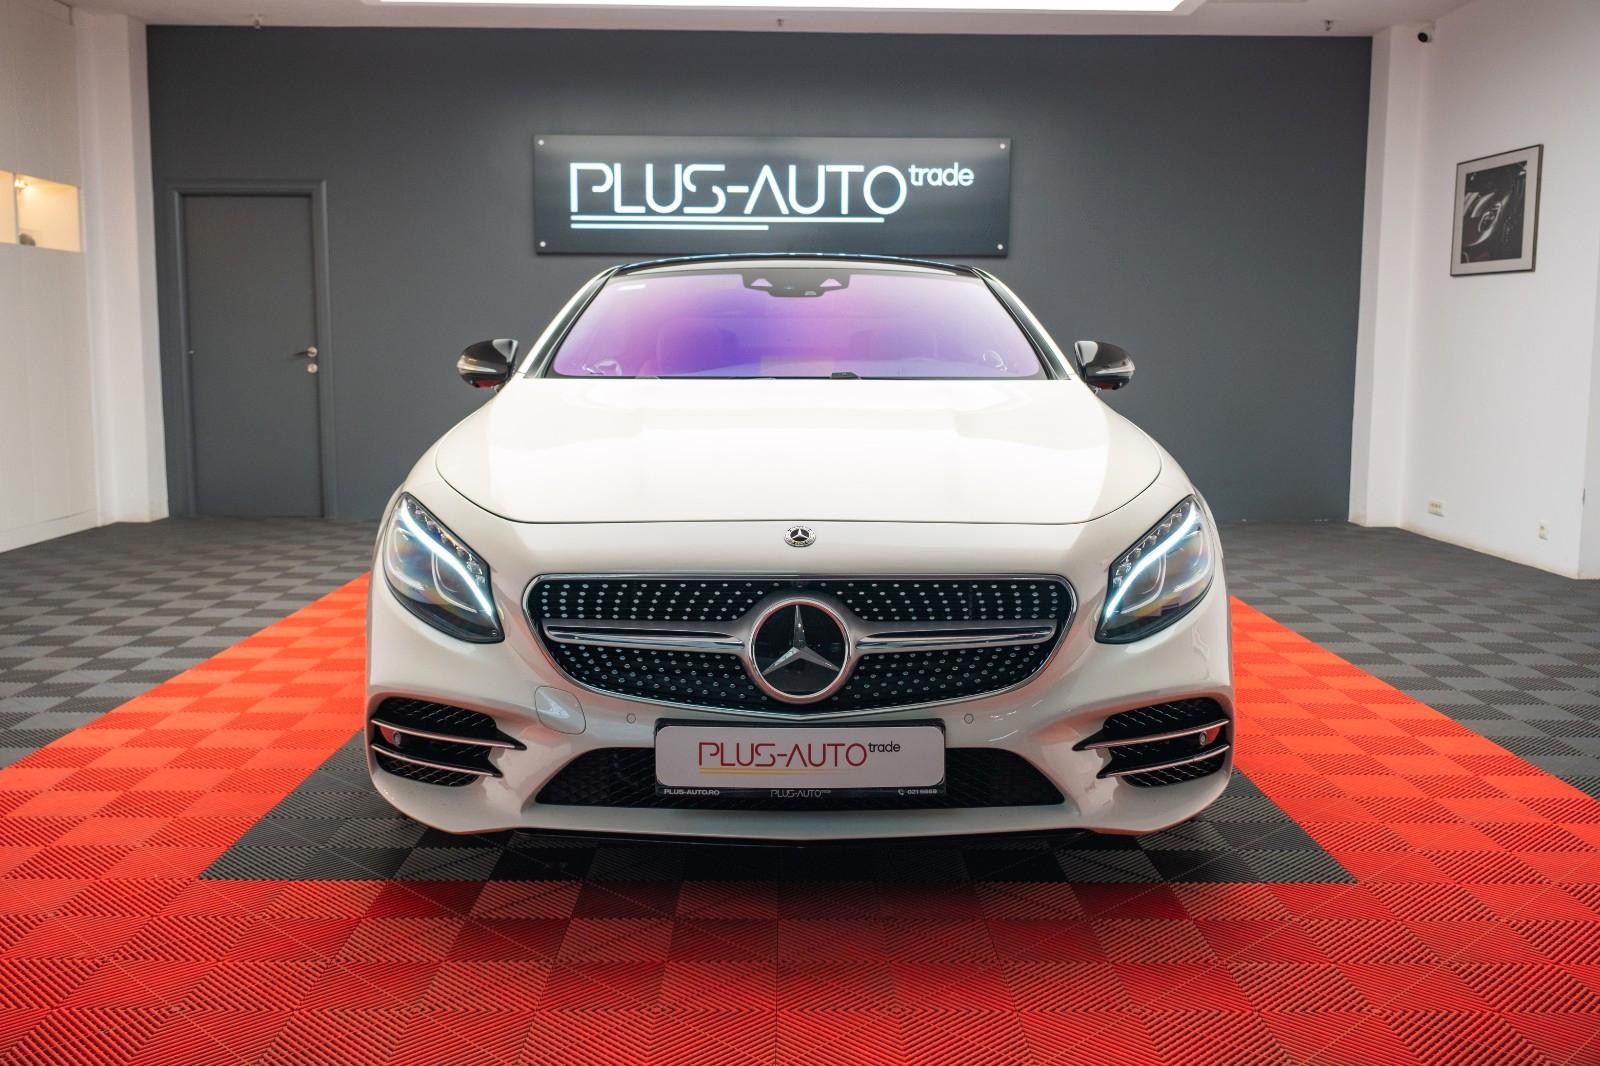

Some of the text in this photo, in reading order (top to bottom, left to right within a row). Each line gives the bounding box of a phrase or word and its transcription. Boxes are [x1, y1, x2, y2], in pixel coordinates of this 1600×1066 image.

[569, 162, 975, 215] PLUS-AUTO trade
[698, 740, 901, 767] PLUS-AUTO trade
[770, 789, 821, 798] PLUS-AUTO
